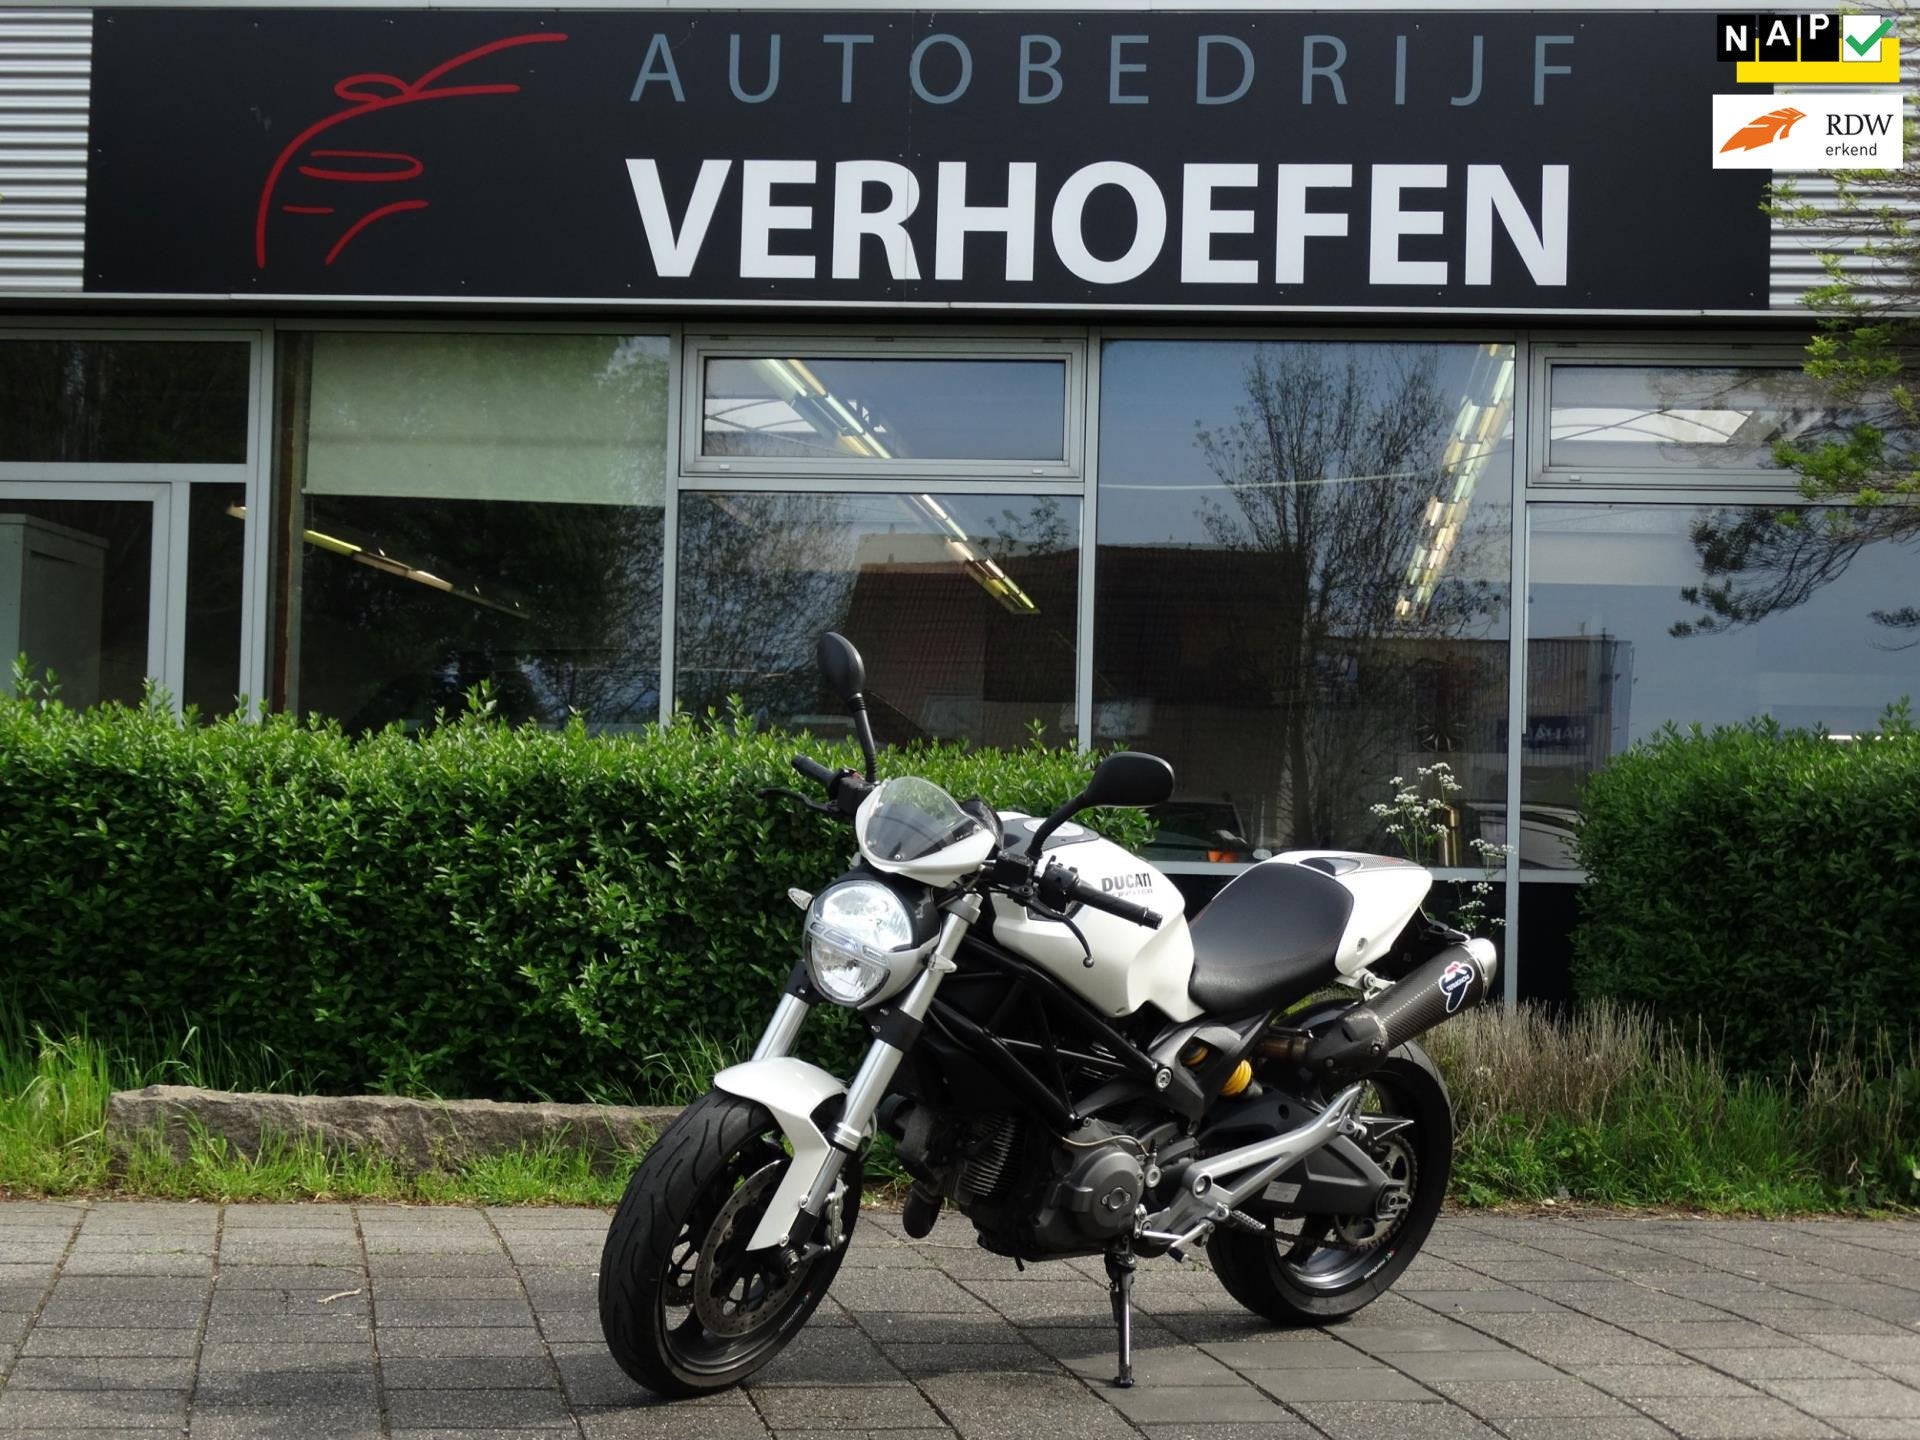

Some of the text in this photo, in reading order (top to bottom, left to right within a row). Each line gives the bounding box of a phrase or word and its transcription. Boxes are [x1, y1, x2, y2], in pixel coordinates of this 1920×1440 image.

[629, 33, 1575, 107] AUTOBEDRIJF
[625, 158, 1570, 287] VERHOEFEN
[1101, 872, 1152, 892] DUCATI
